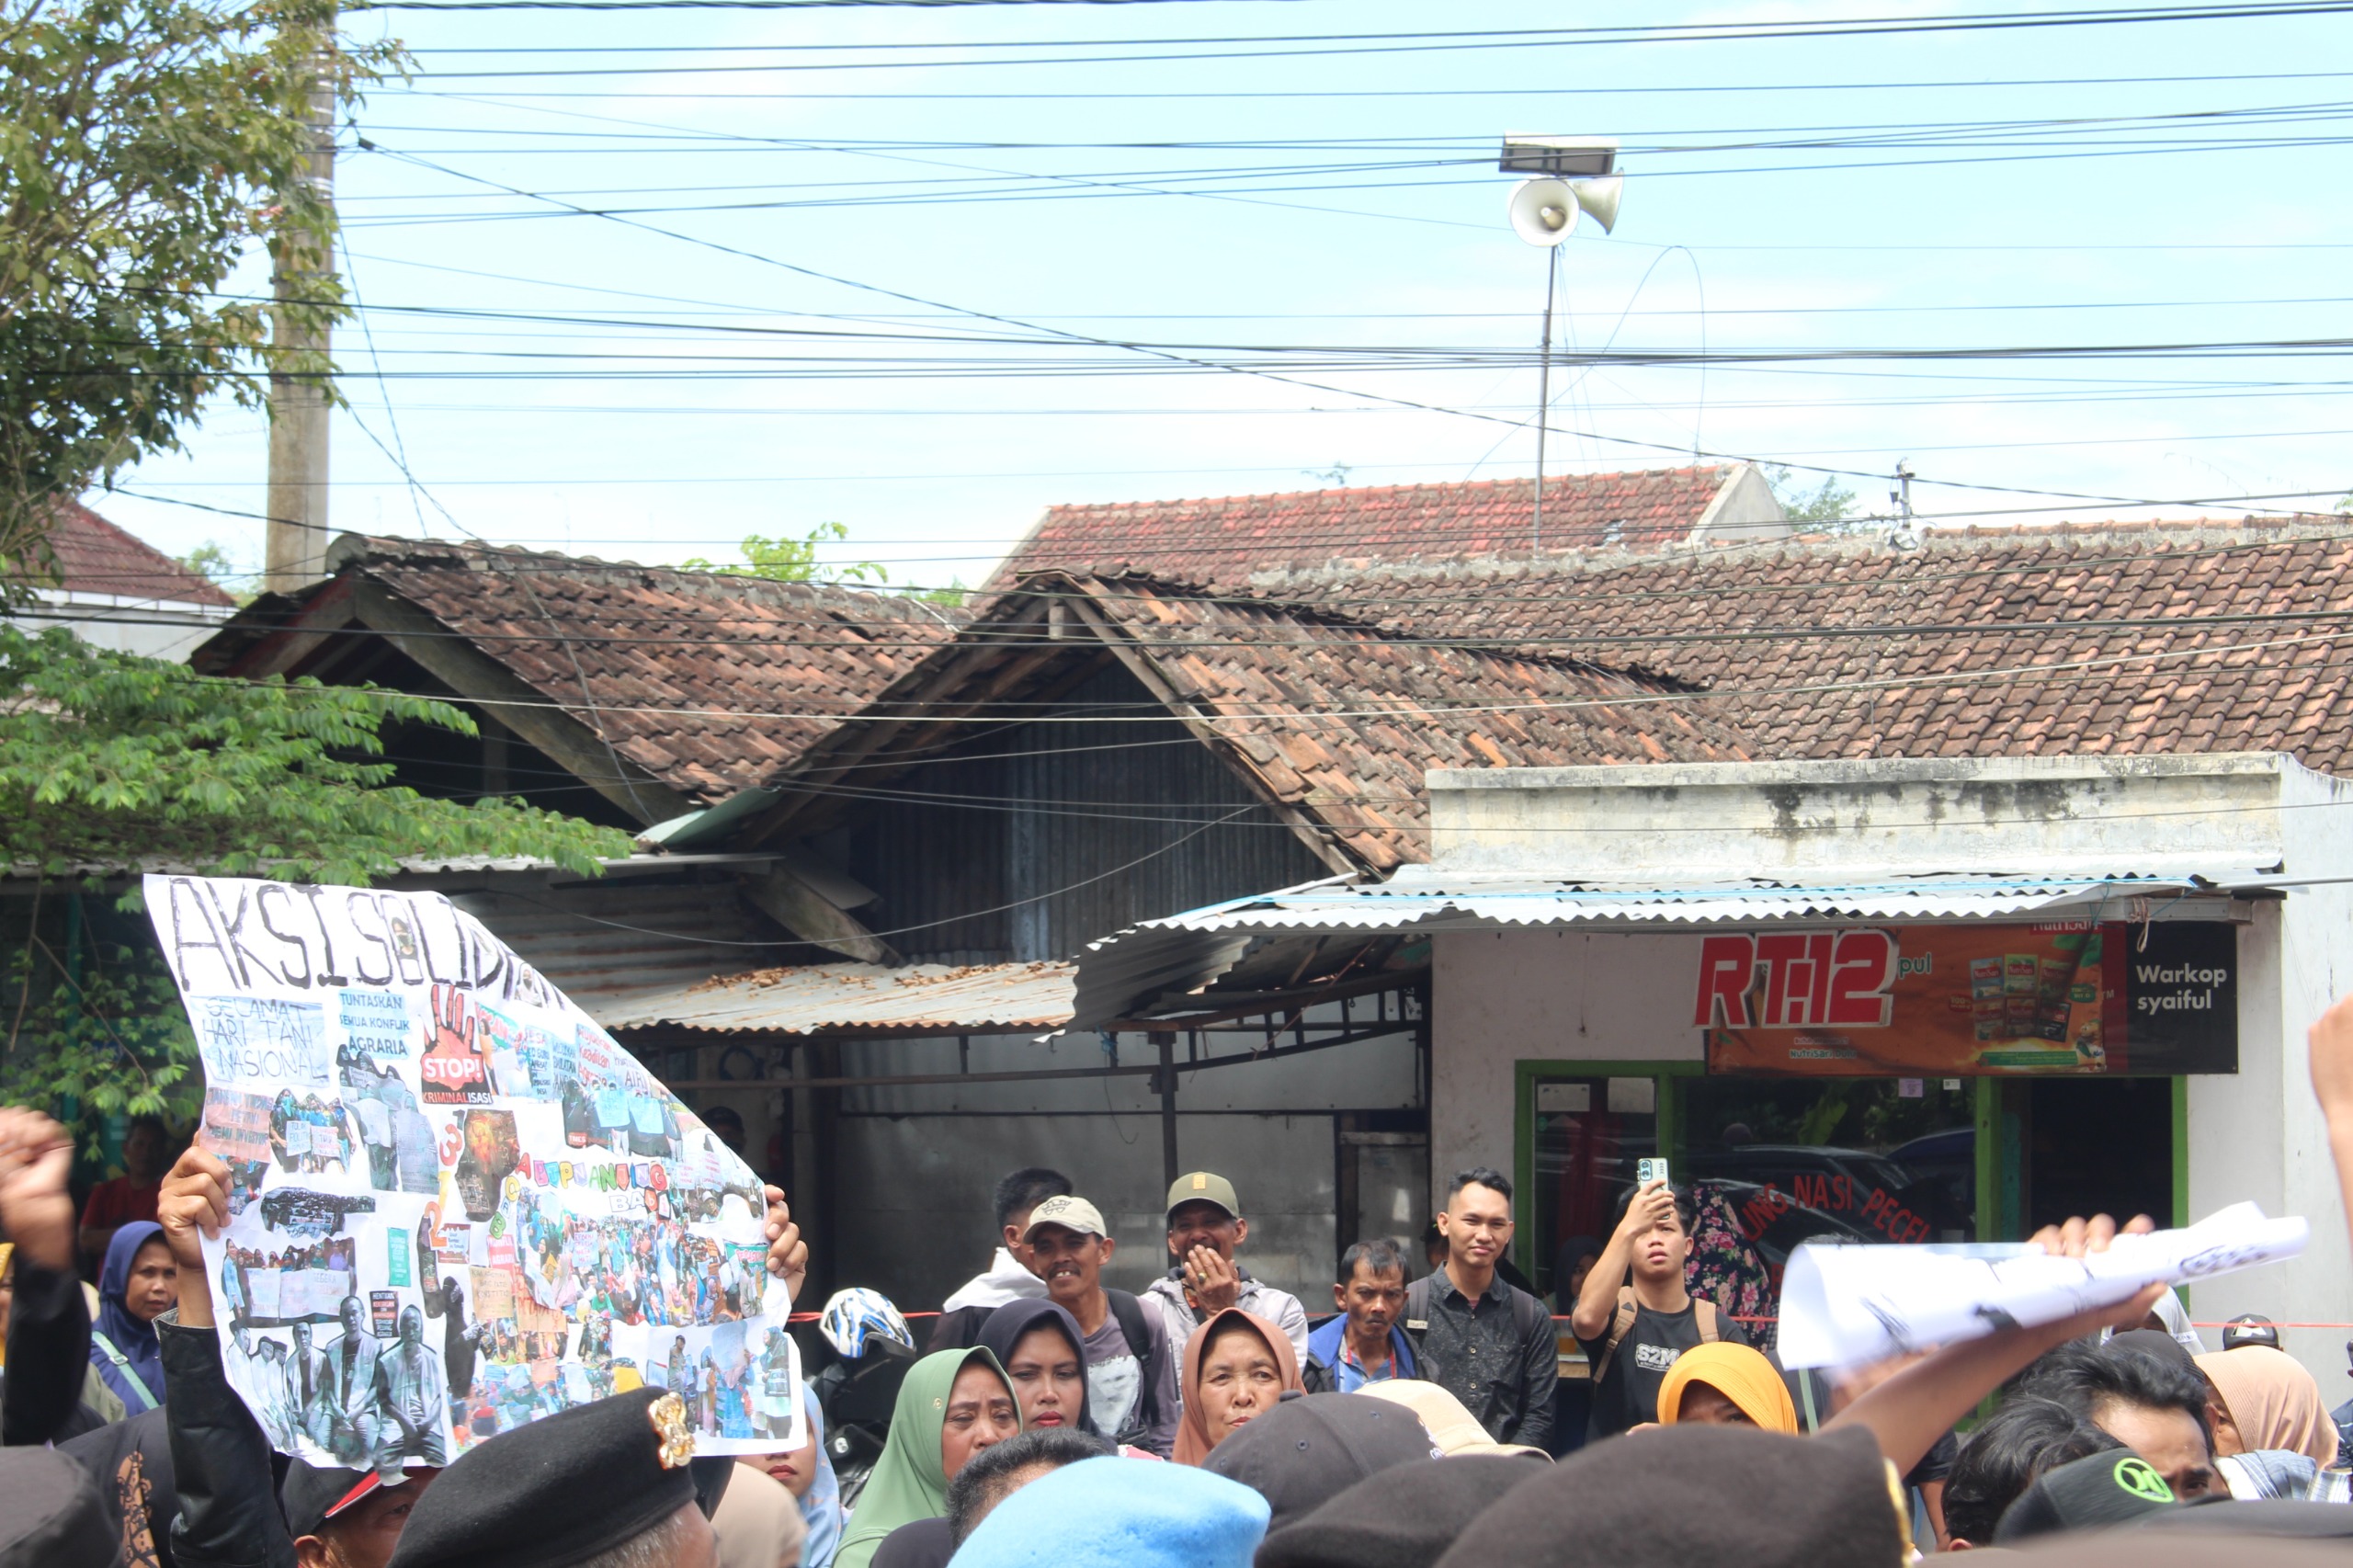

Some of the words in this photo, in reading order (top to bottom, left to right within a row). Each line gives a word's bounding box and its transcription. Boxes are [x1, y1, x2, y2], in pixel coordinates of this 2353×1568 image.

[168, 876, 347, 993] AKSI
[1897, 952, 1932, 980] pul
[2135, 962, 2228, 988] Warkop
[339, 993, 403, 1009] TUNTASKAN
[2136, 988, 2212, 1017] syaiful
[201, 1018, 246, 1047] HARI
[259, 1020, 314, 1050] TANI
[339, 1015, 368, 1028] SEMUA
[369, 1017, 410, 1031] KONFLIK
[348, 1035, 408, 1055] AGRARIA
[1790, 1049, 1833, 1059] NutriSari
[217, 1048, 329, 1081] NASIONAL
[424, 1058, 483, 1078] STOP!
[423, 1092, 493, 1104] KRIMINALISASI
[1740, 1181, 1790, 1242] UNG
[1793, 1175, 1854, 1210] NASI
[1637, 1345, 1677, 1366] S2M
